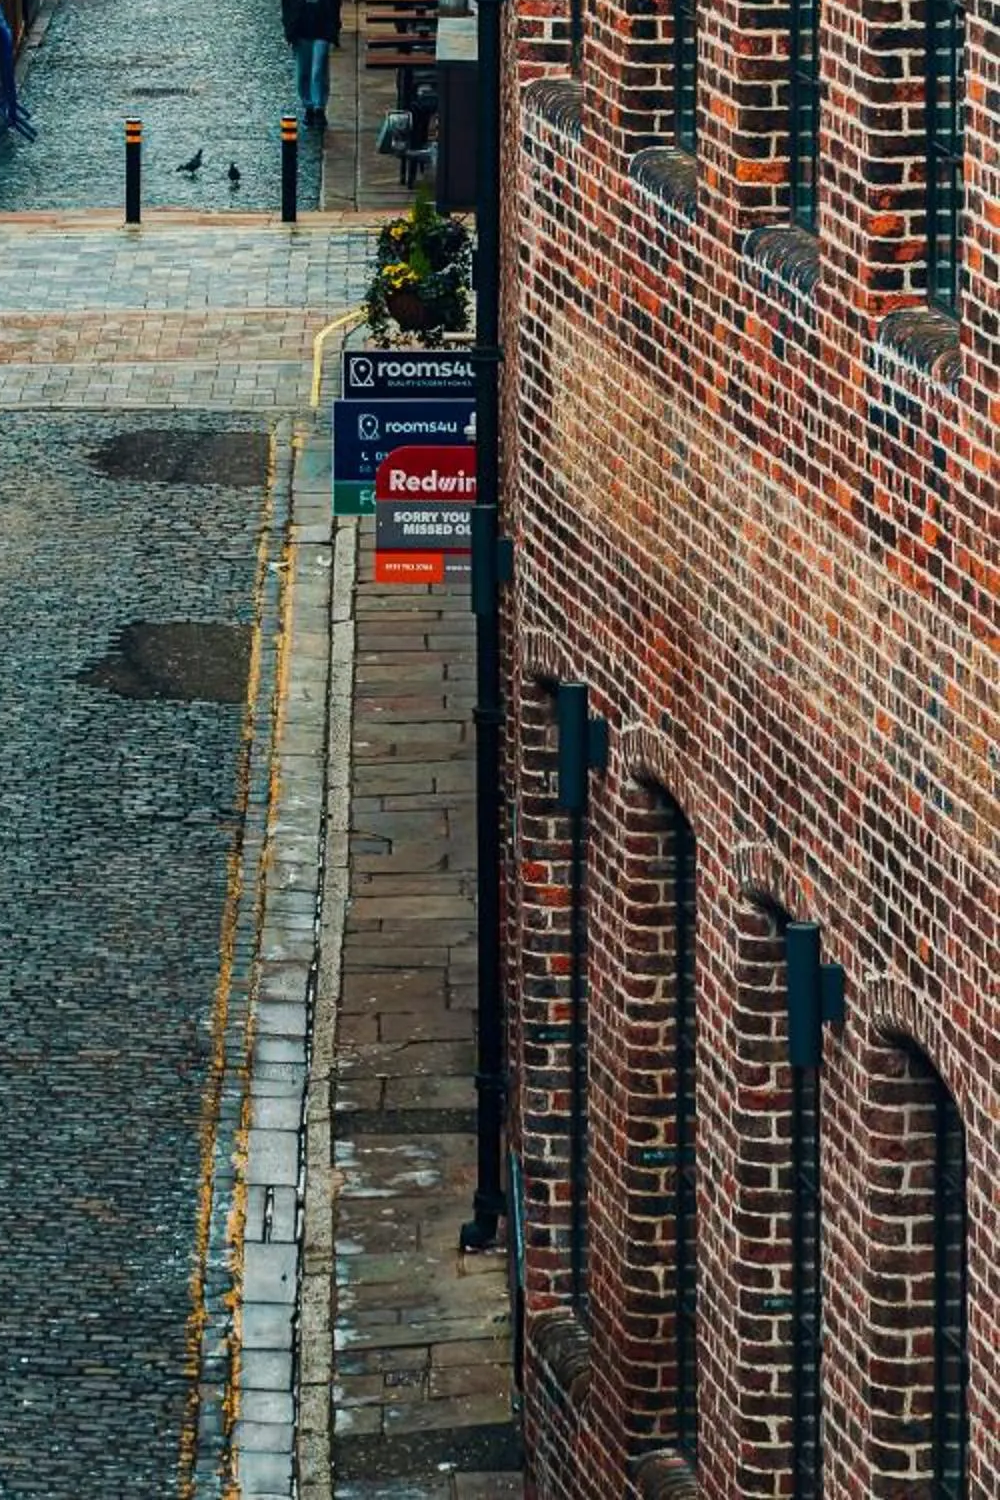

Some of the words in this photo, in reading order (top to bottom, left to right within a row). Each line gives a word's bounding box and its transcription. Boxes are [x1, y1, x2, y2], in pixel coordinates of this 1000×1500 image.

[385, 421, 457, 433] rooms4u
[393, 511, 439, 522] SORRY
[441, 511, 471, 522] YOU
[403, 524, 453, 535] MISSED
